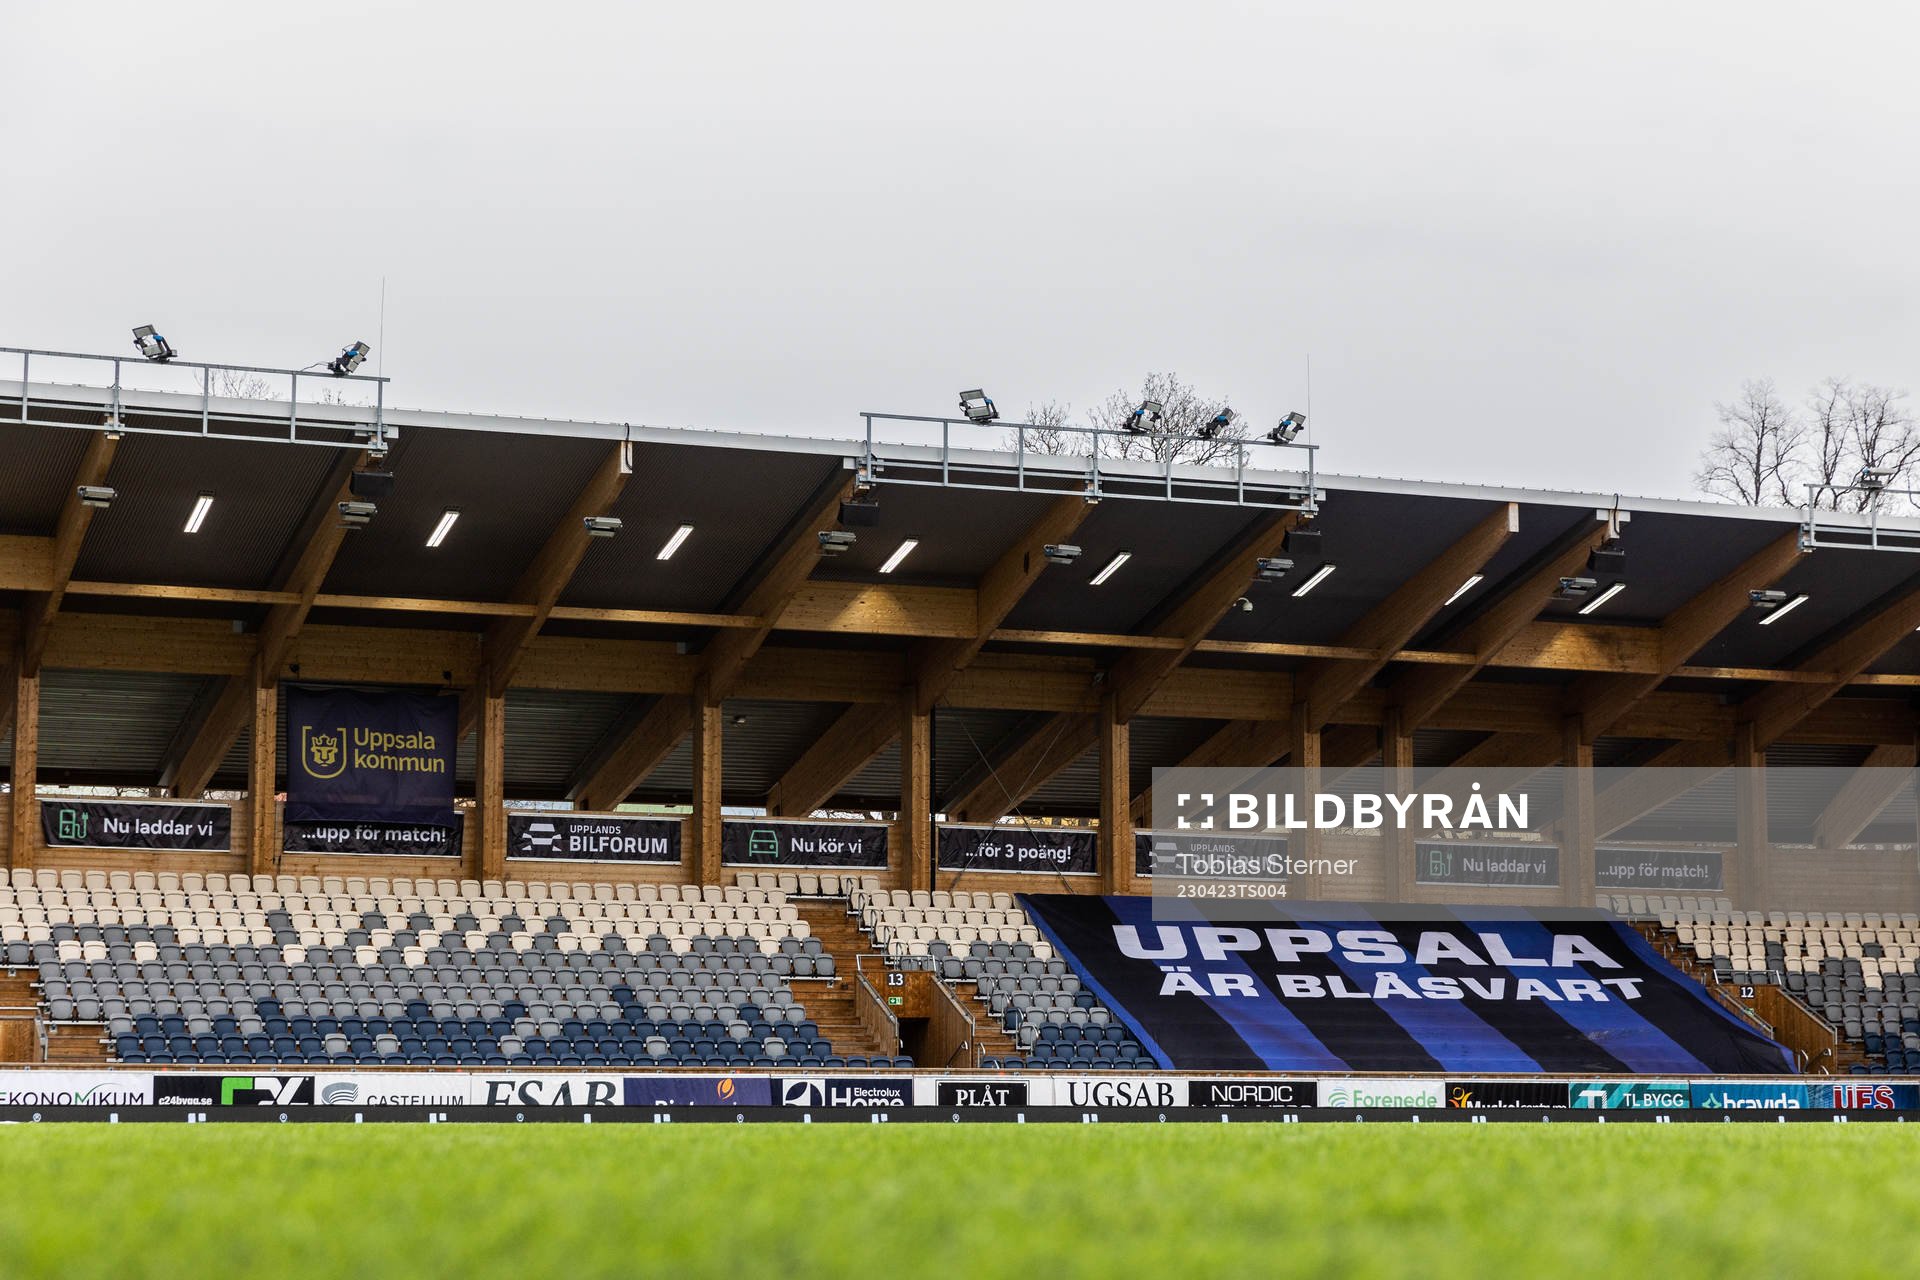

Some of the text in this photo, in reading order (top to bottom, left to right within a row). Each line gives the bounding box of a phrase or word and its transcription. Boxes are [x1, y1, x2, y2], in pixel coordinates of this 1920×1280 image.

[354, 727, 436, 752] Uppsala
[354, 748, 445, 774] kommun
[103, 817, 213, 837] Nu laddar vi
[354, 824, 381, 841] för
[384, 825, 447, 843] match!
[569, 824, 621, 835] UPPLANDS
[569, 836, 668, 854] BILFORUM
[791, 837, 862, 854] Nu kör vi
[1004, 843, 1014, 858] 3
[1018, 844, 1072, 864] poäng!
[1190, 843, 1236, 853] UPPLANDS
[1462, 857, 1547, 874] Nu laddar vi
[1638, 863, 1659, 877] för
[1662, 864, 1709, 879] match!
[1111, 924, 1625, 969] UPPSALA
[888, 973, 904, 986] 13
[1158, 966, 1645, 1002] ÄR BLÅSVART
[1740, 986, 1755, 998] 12
[854, 1087, 901, 1097] Electrolux
[956, 1085, 1010, 1107] PLÅT
[1067, 1082, 1175, 1107] UGSAB
[1211, 1085, 1293, 1102] NORDIC
[1353, 1089, 1437, 1108] Forenede
[1623, 1093, 1641, 1107] TL
[1643, 1093, 1684, 1107] BYGG
